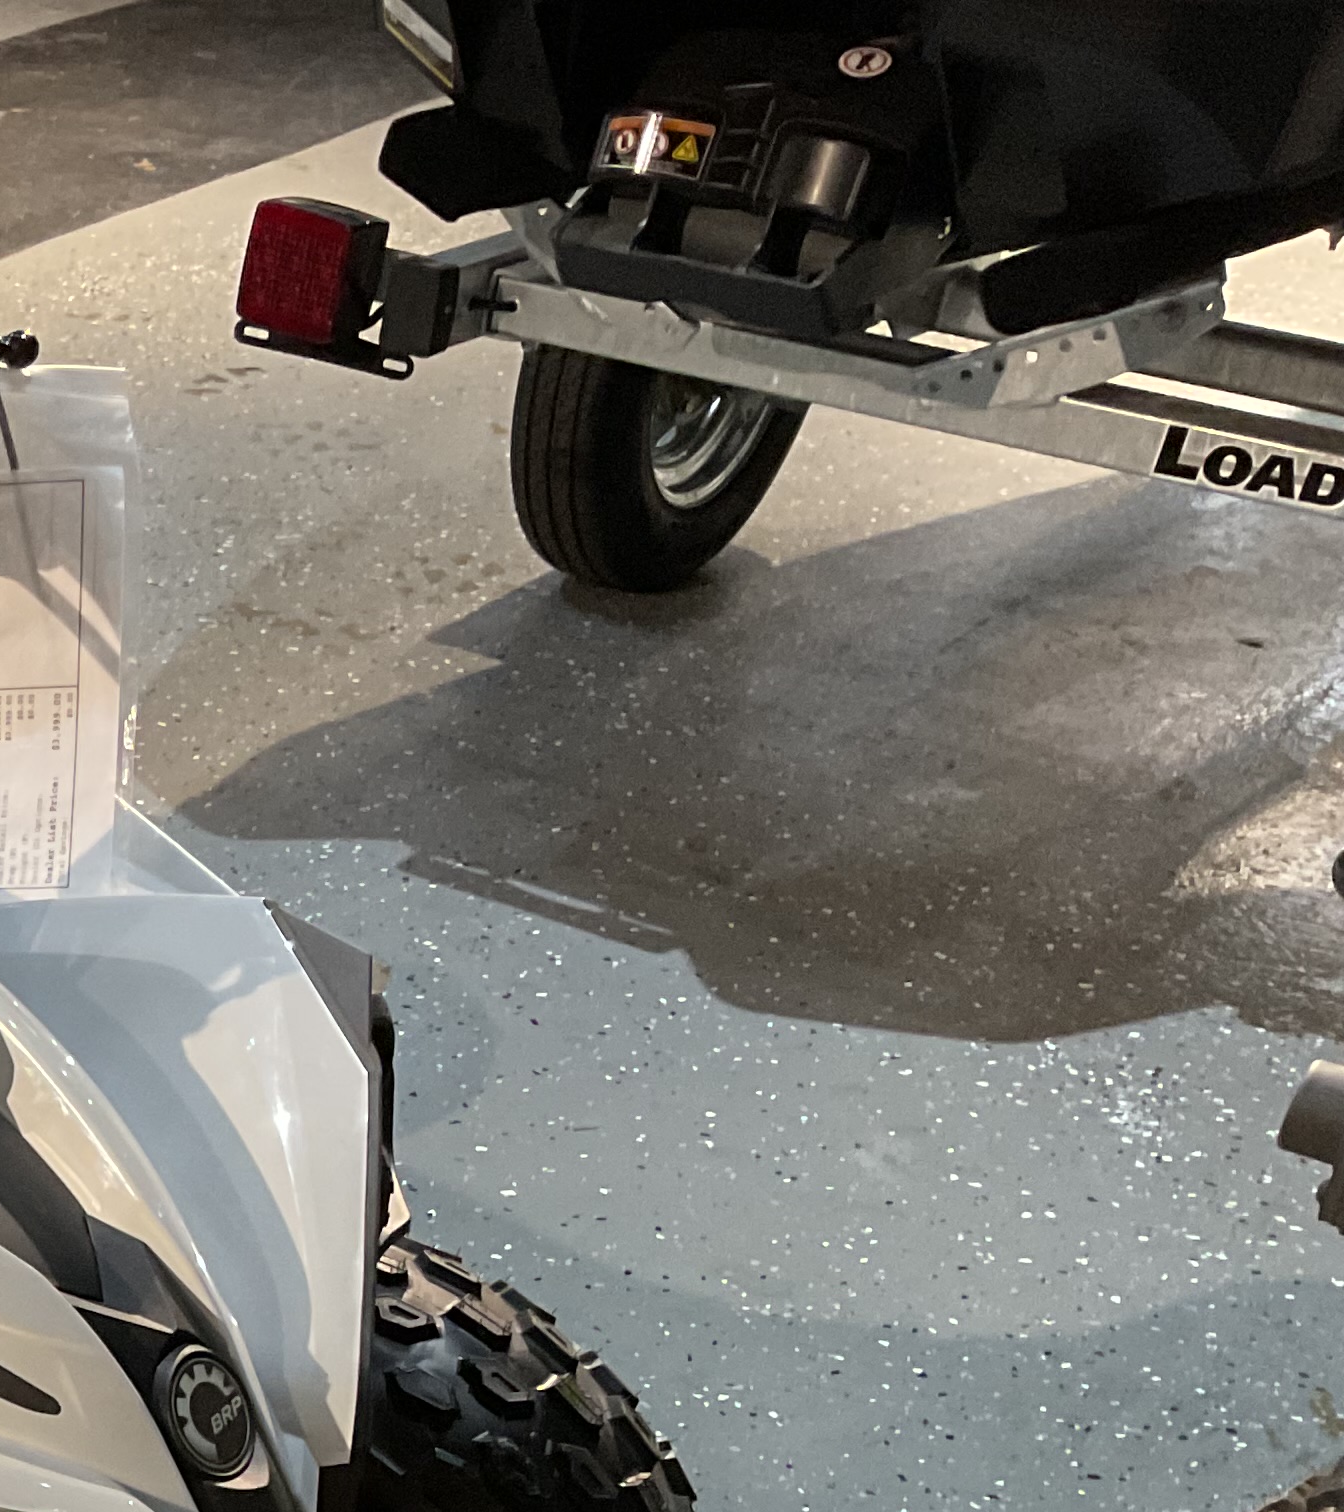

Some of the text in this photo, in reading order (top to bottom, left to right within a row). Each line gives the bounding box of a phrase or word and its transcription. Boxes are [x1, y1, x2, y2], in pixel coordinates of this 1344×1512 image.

[1153, 424, 1344, 507] LOAD
[47, 818, 57, 843] List
[210, 1396, 242, 1435] BRP
